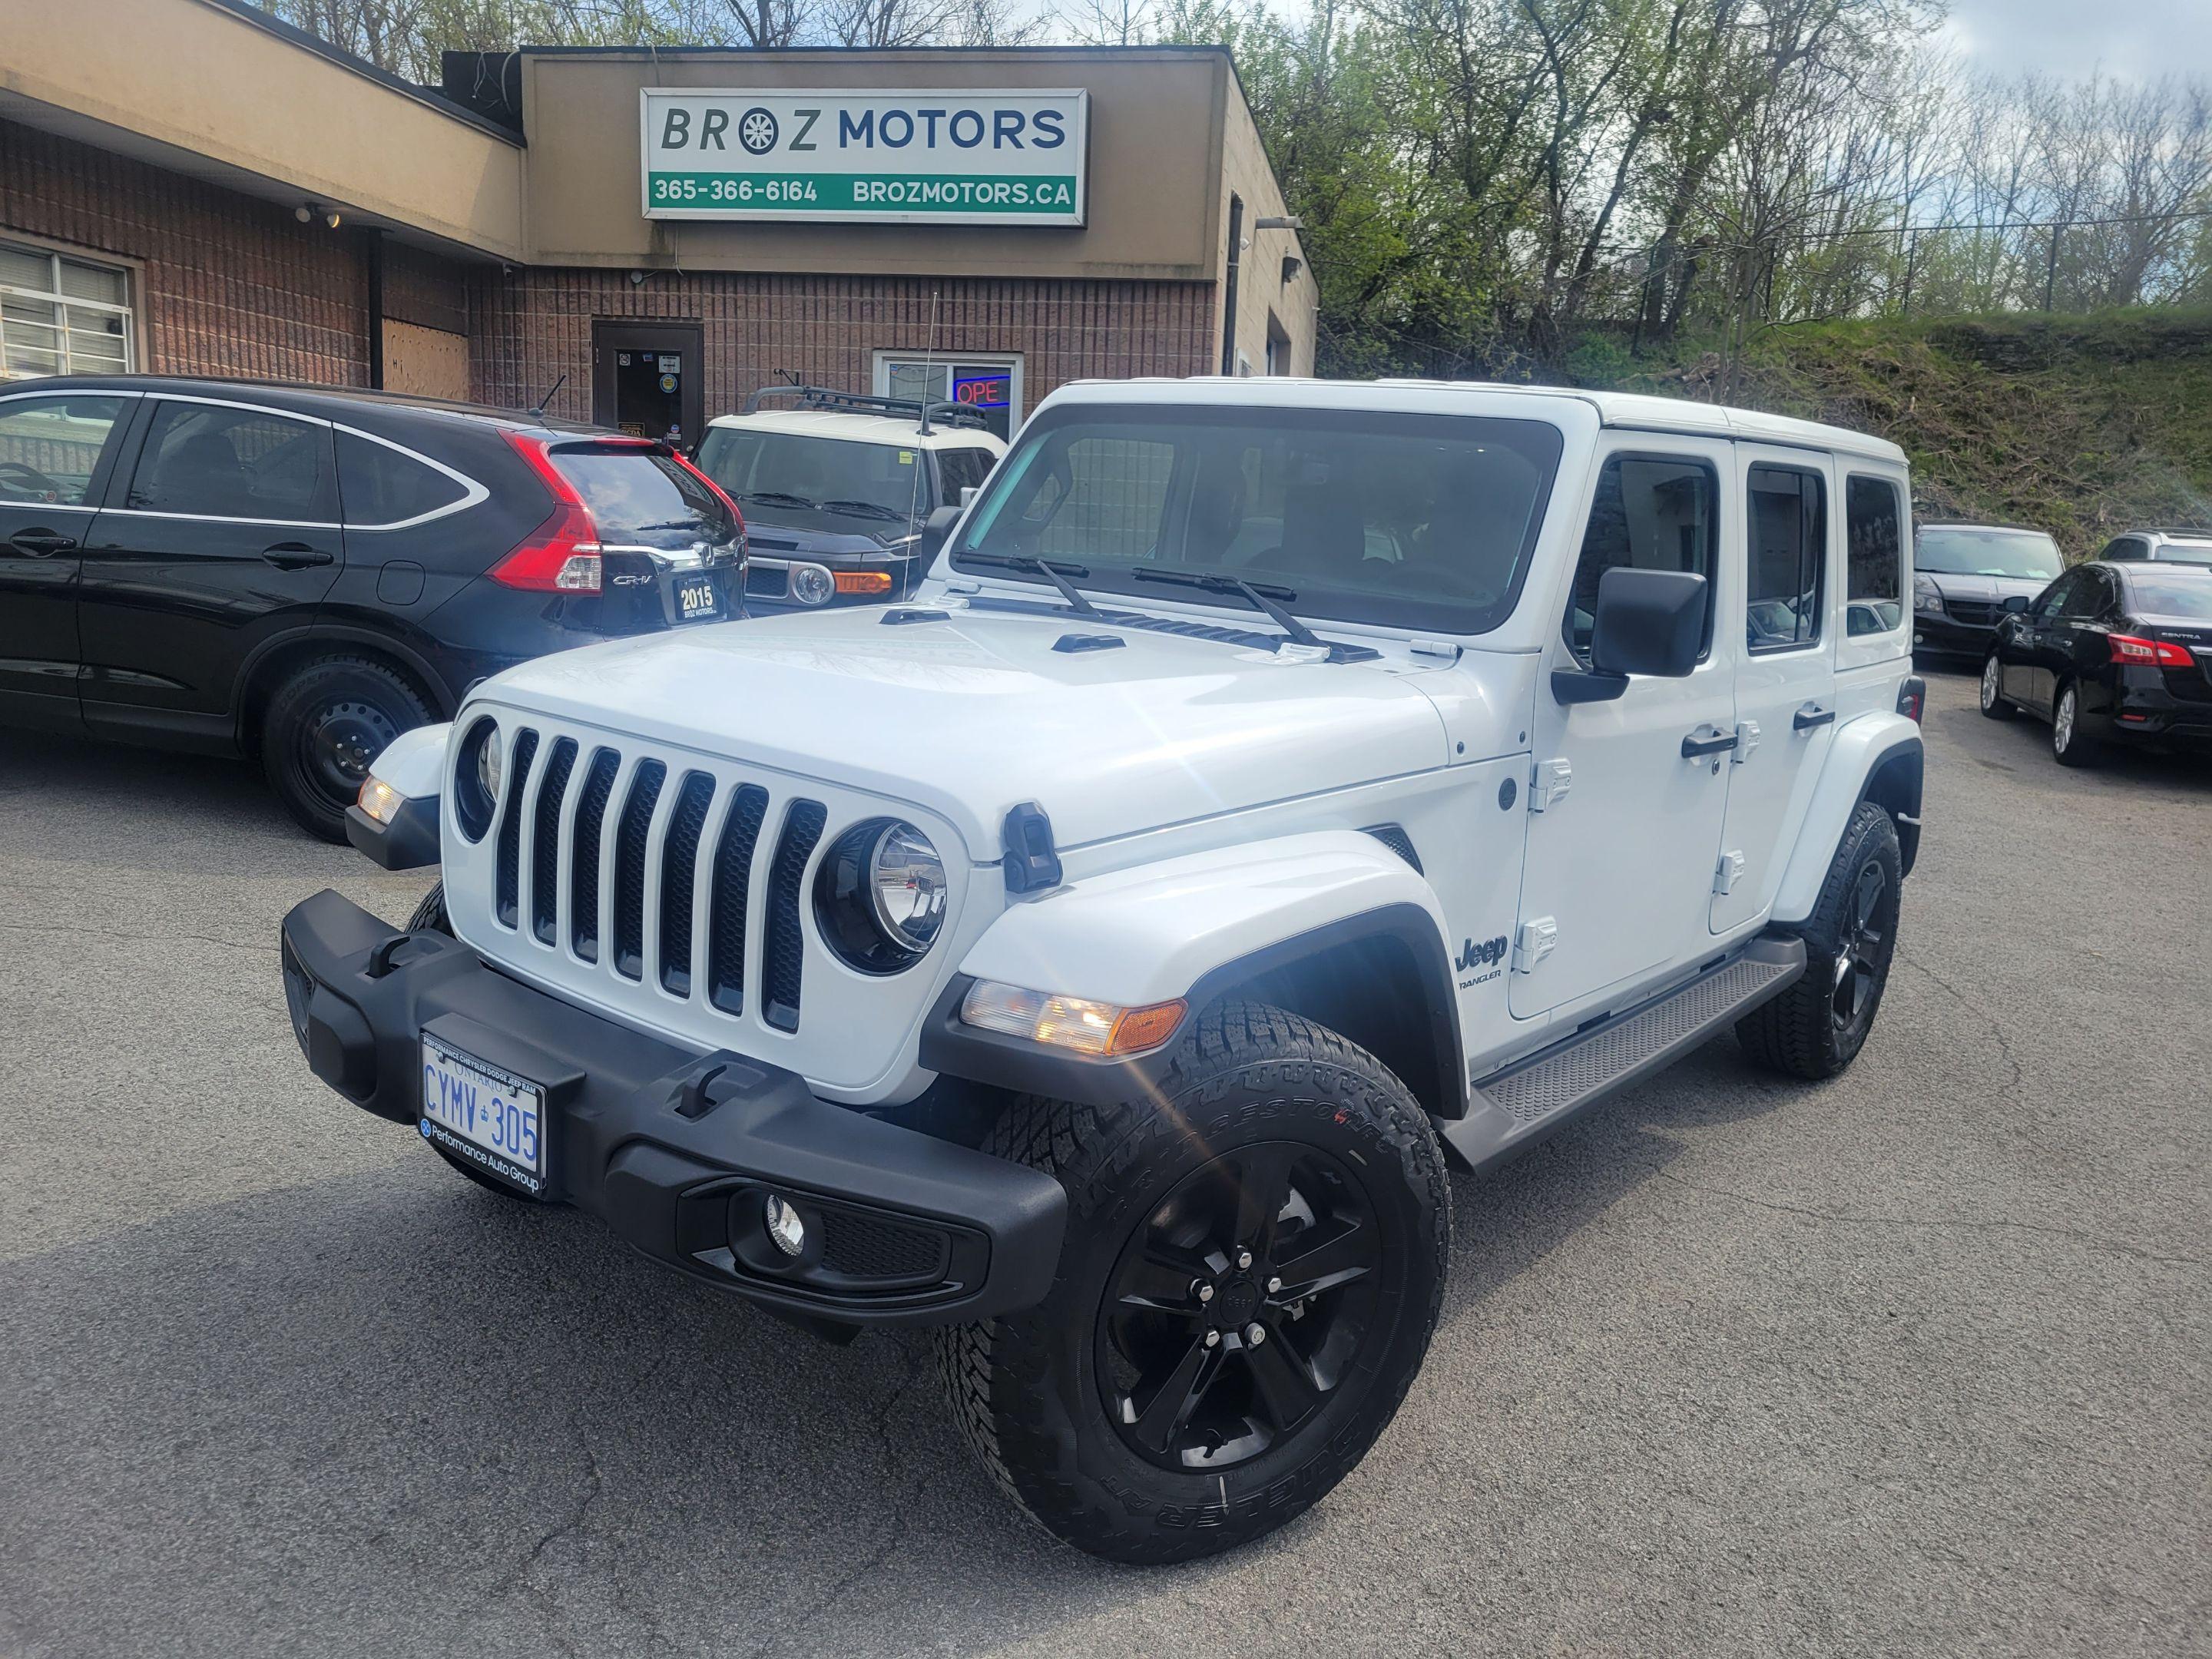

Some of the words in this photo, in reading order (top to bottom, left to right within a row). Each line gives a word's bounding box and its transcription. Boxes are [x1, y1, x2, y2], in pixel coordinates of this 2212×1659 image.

[839, 109, 1066, 148] MOTORS
[654, 179, 817, 202] 365-366-6164
[853, 181, 1071, 204] BROZMOTORS.CA
[680, 585, 714, 611] 2015
[2161, 631, 2201, 640] SENTRA
[1455, 935, 1508, 972] Jeep
[423, 1036, 460, 1061] PERFORMANCE
[459, 1055, 487, 1074] CHRYSLER
[487, 1067, 508, 1082] DODGE
[507, 1076, 522, 1089] JEEP
[522, 1082, 537, 1095] RAM
[424, 1064, 478, 1134] CYMV
[491, 1096, 537, 1162] 305
[432, 1124, 488, 1165] Performance
[487, 1156, 509, 1174] Auto
[510, 1166, 540, 1194] Group
